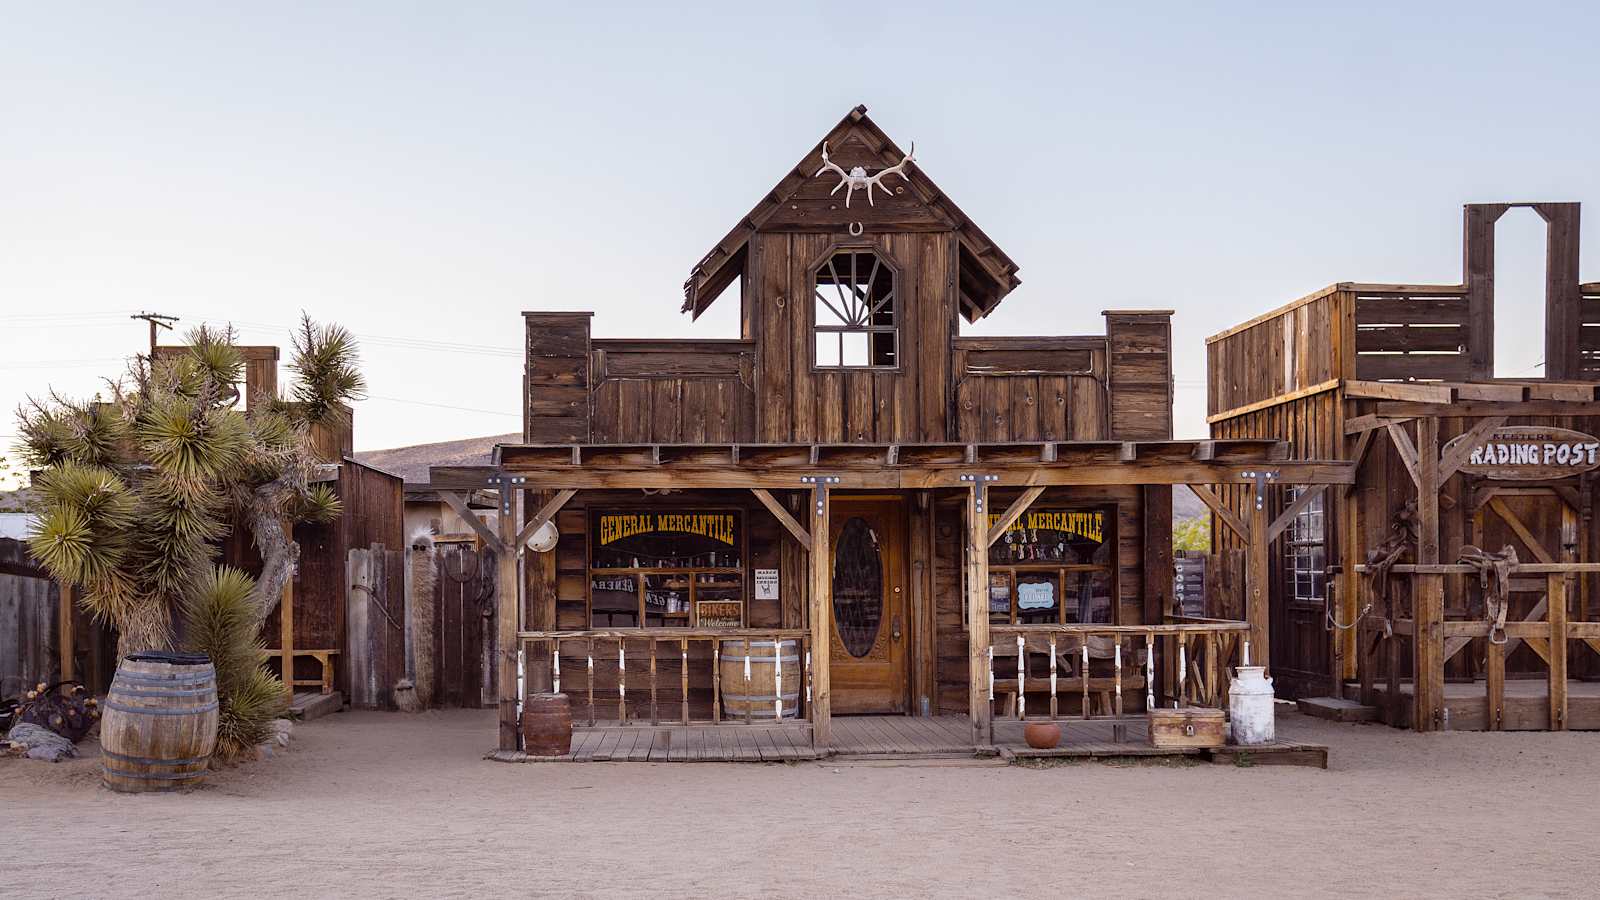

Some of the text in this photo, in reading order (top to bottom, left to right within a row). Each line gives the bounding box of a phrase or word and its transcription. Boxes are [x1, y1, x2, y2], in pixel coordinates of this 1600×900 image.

[1470, 442, 1600, 465] RADING POST
[600, 514, 733, 545] GENERAL MERCANTILE
[987, 511, 1103, 544] NEAL MERCANTILE
[701, 617, 739, 628] Welcome
